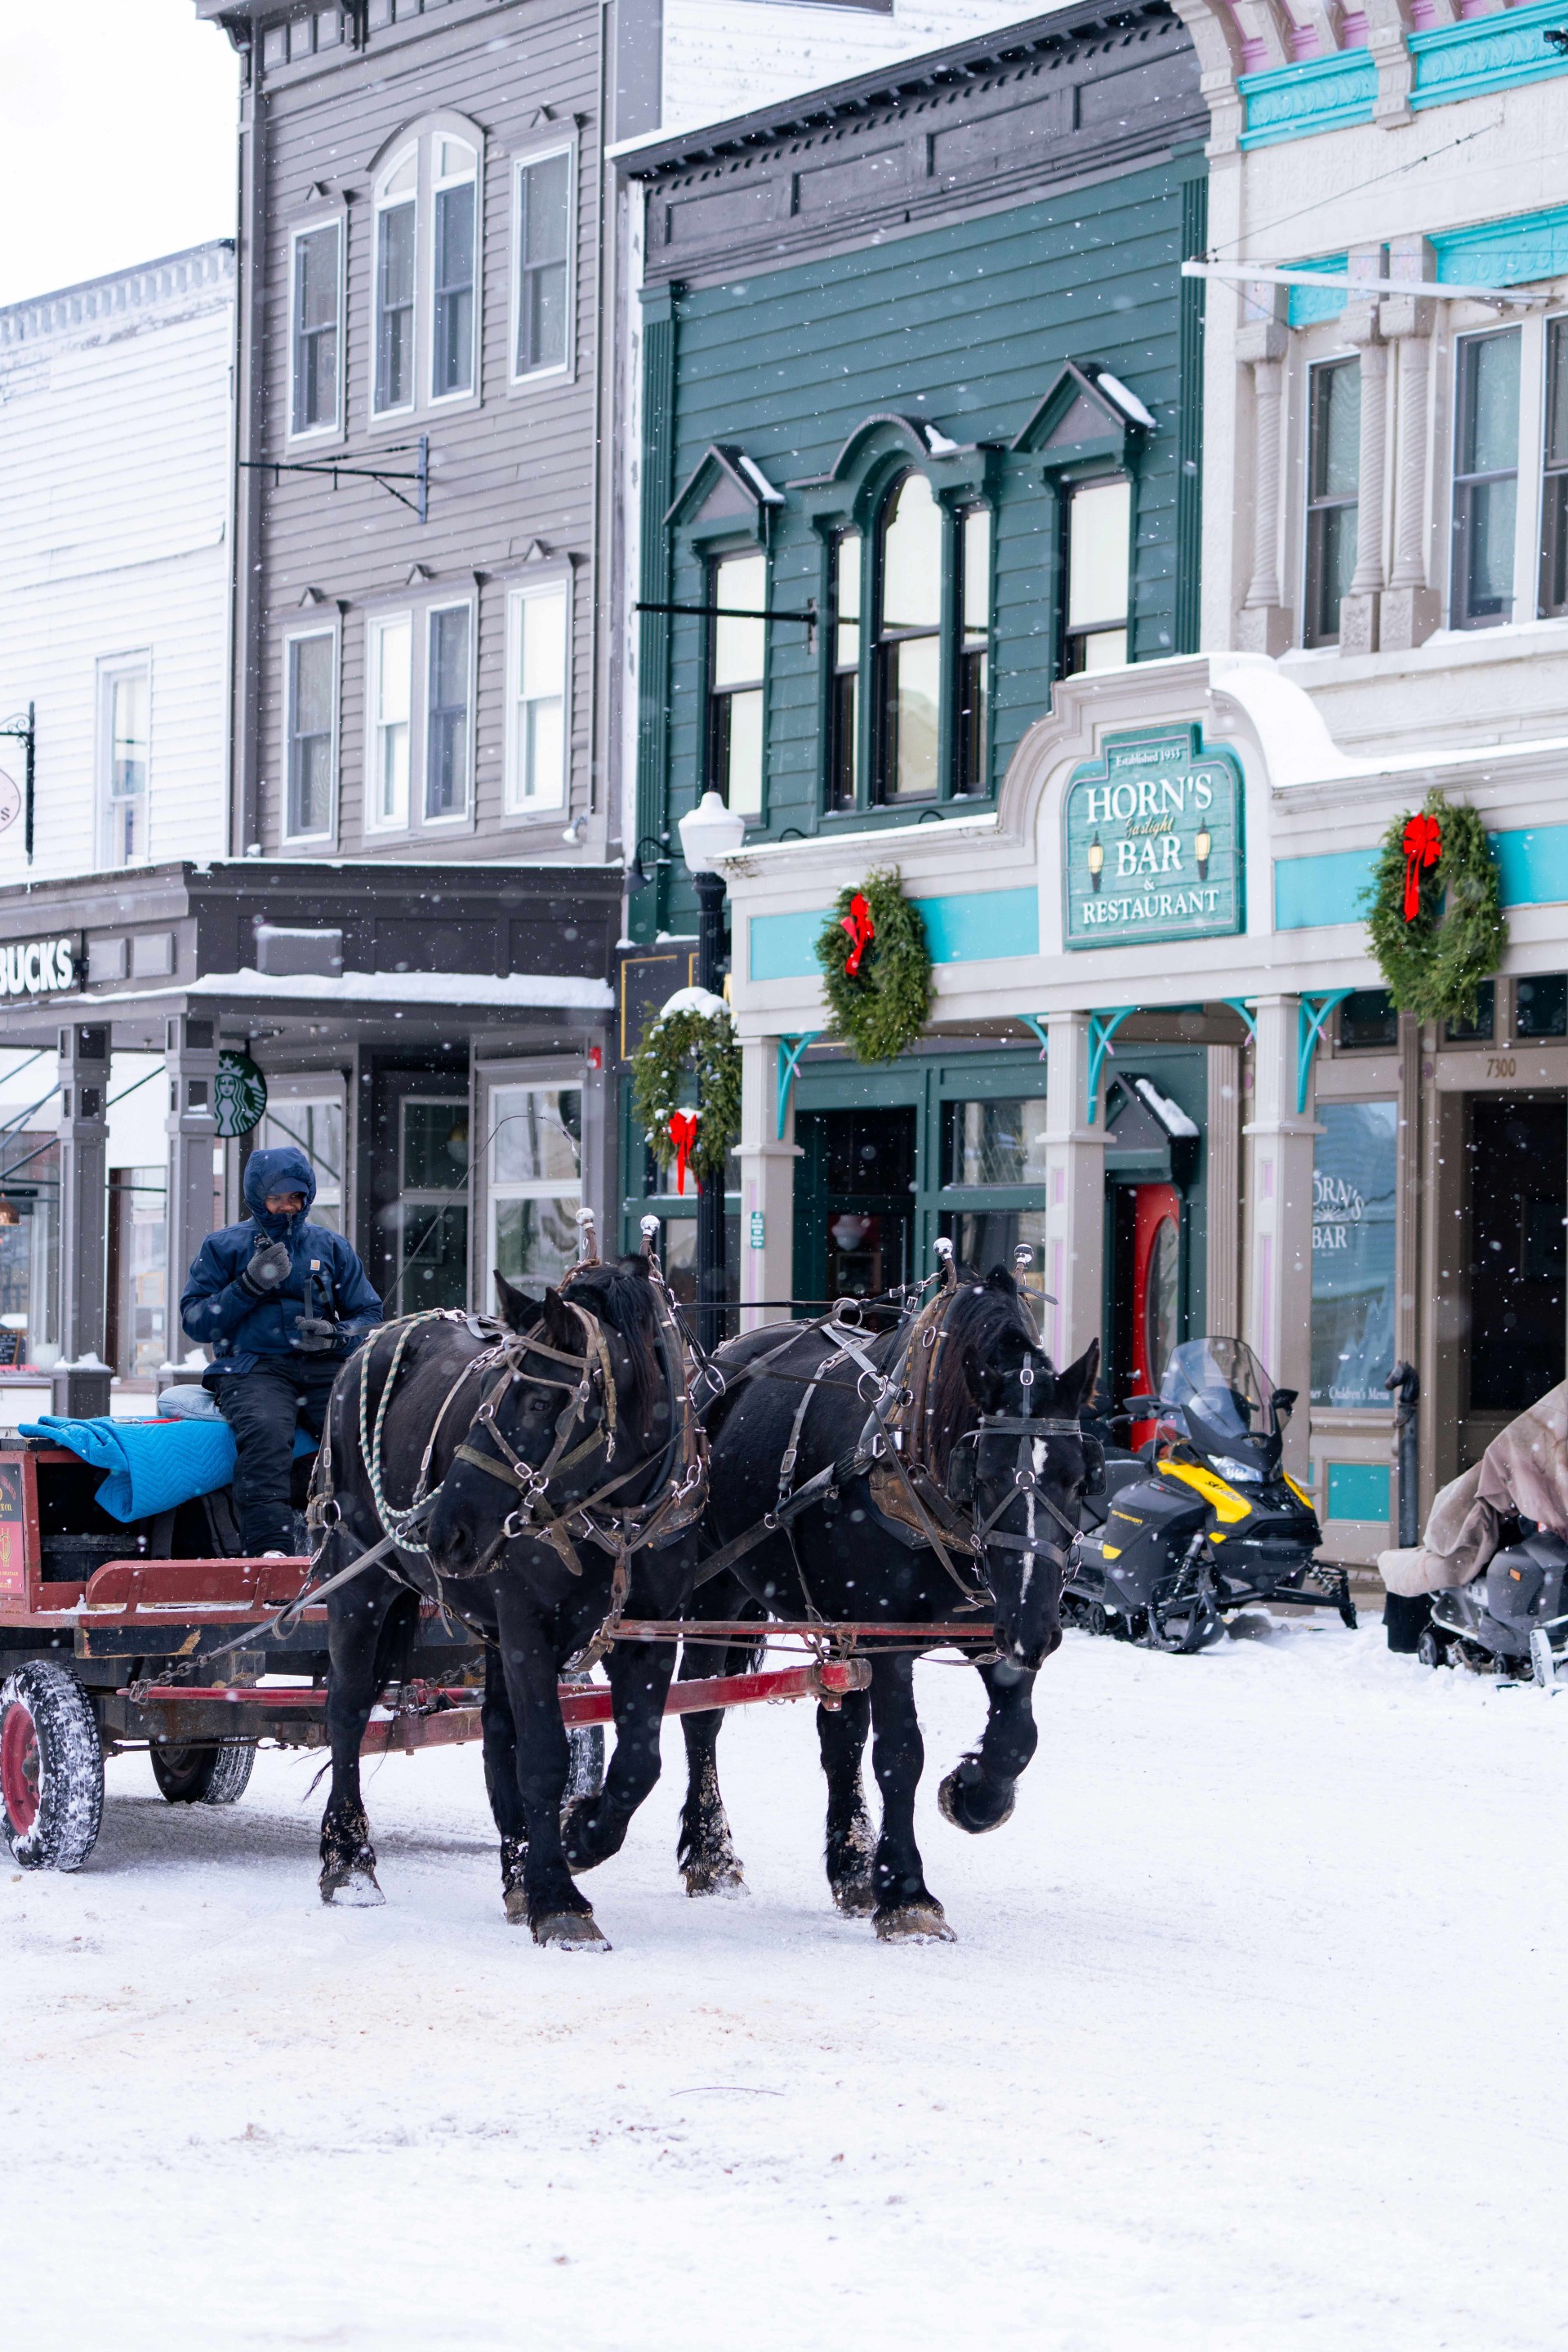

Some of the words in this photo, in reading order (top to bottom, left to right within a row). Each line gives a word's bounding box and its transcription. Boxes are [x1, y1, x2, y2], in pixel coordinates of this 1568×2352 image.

[1116, 752, 1159, 768] Established
[1160, 748, 1181, 762] 1933
[1086, 773, 1213, 824] HORN'S
[1125, 815, 1175, 840] Gaslight
[1116, 835, 1183, 878] BAR
[1143, 878, 1156, 891] &
[1083, 889, 1219, 924] RESTAURANT
[1487, 1058, 1517, 1078] 7300
[1312, 1226, 1348, 1249] BAR
[1368, 1388, 1390, 1400] Menu
